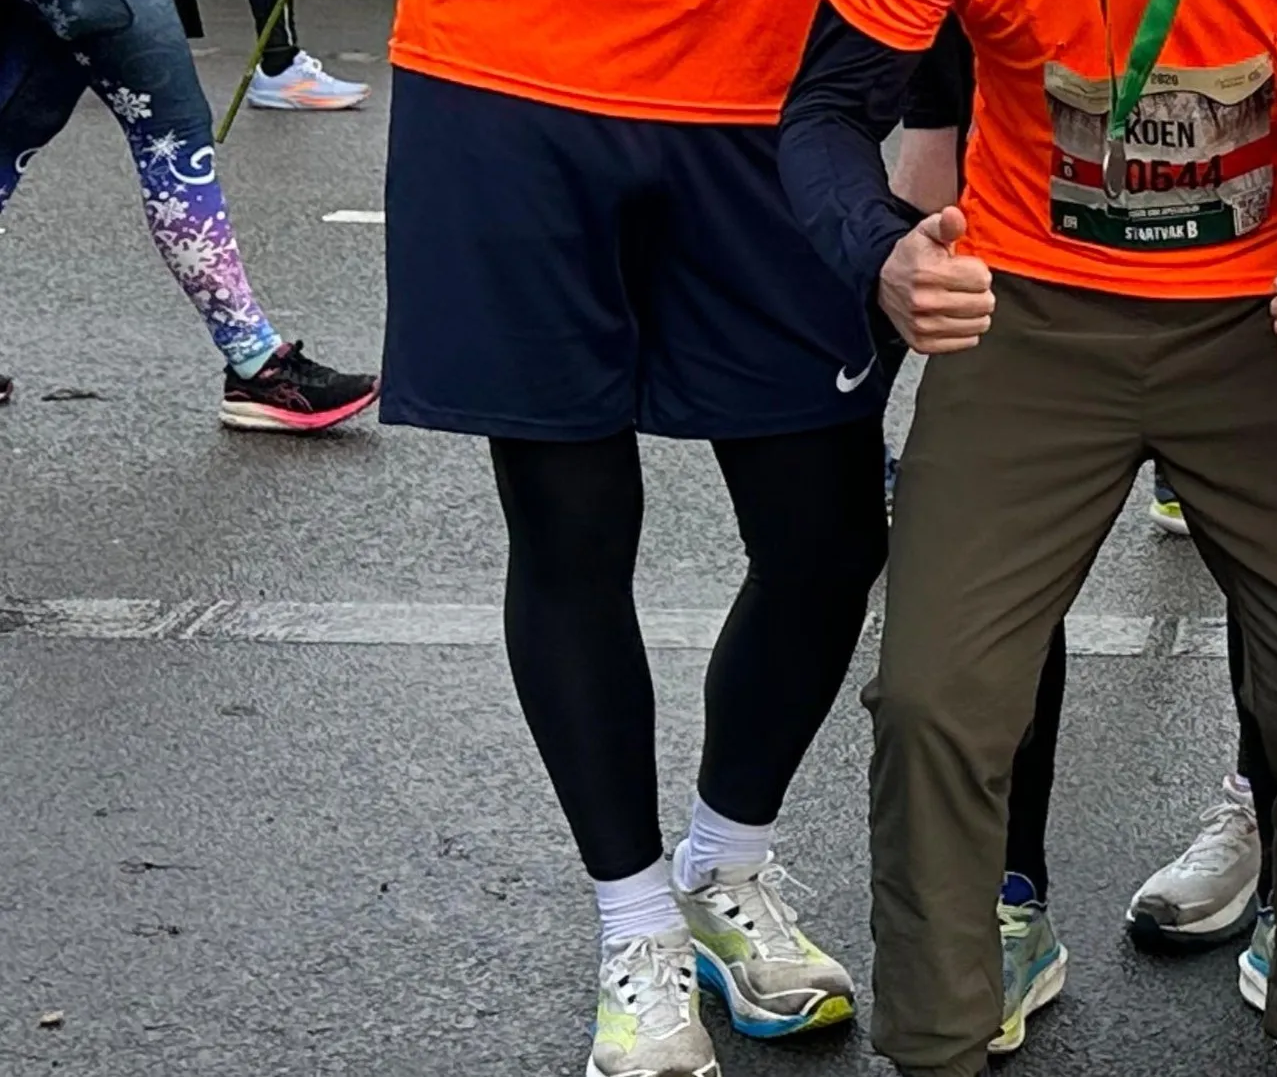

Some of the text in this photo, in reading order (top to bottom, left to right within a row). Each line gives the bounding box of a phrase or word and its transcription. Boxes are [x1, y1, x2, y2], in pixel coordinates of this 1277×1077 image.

[1125, 118, 1195, 148] KOEN
[1124, 154, 1222, 195] 0544
[1124, 220, 1199, 241] STARTVAK B
